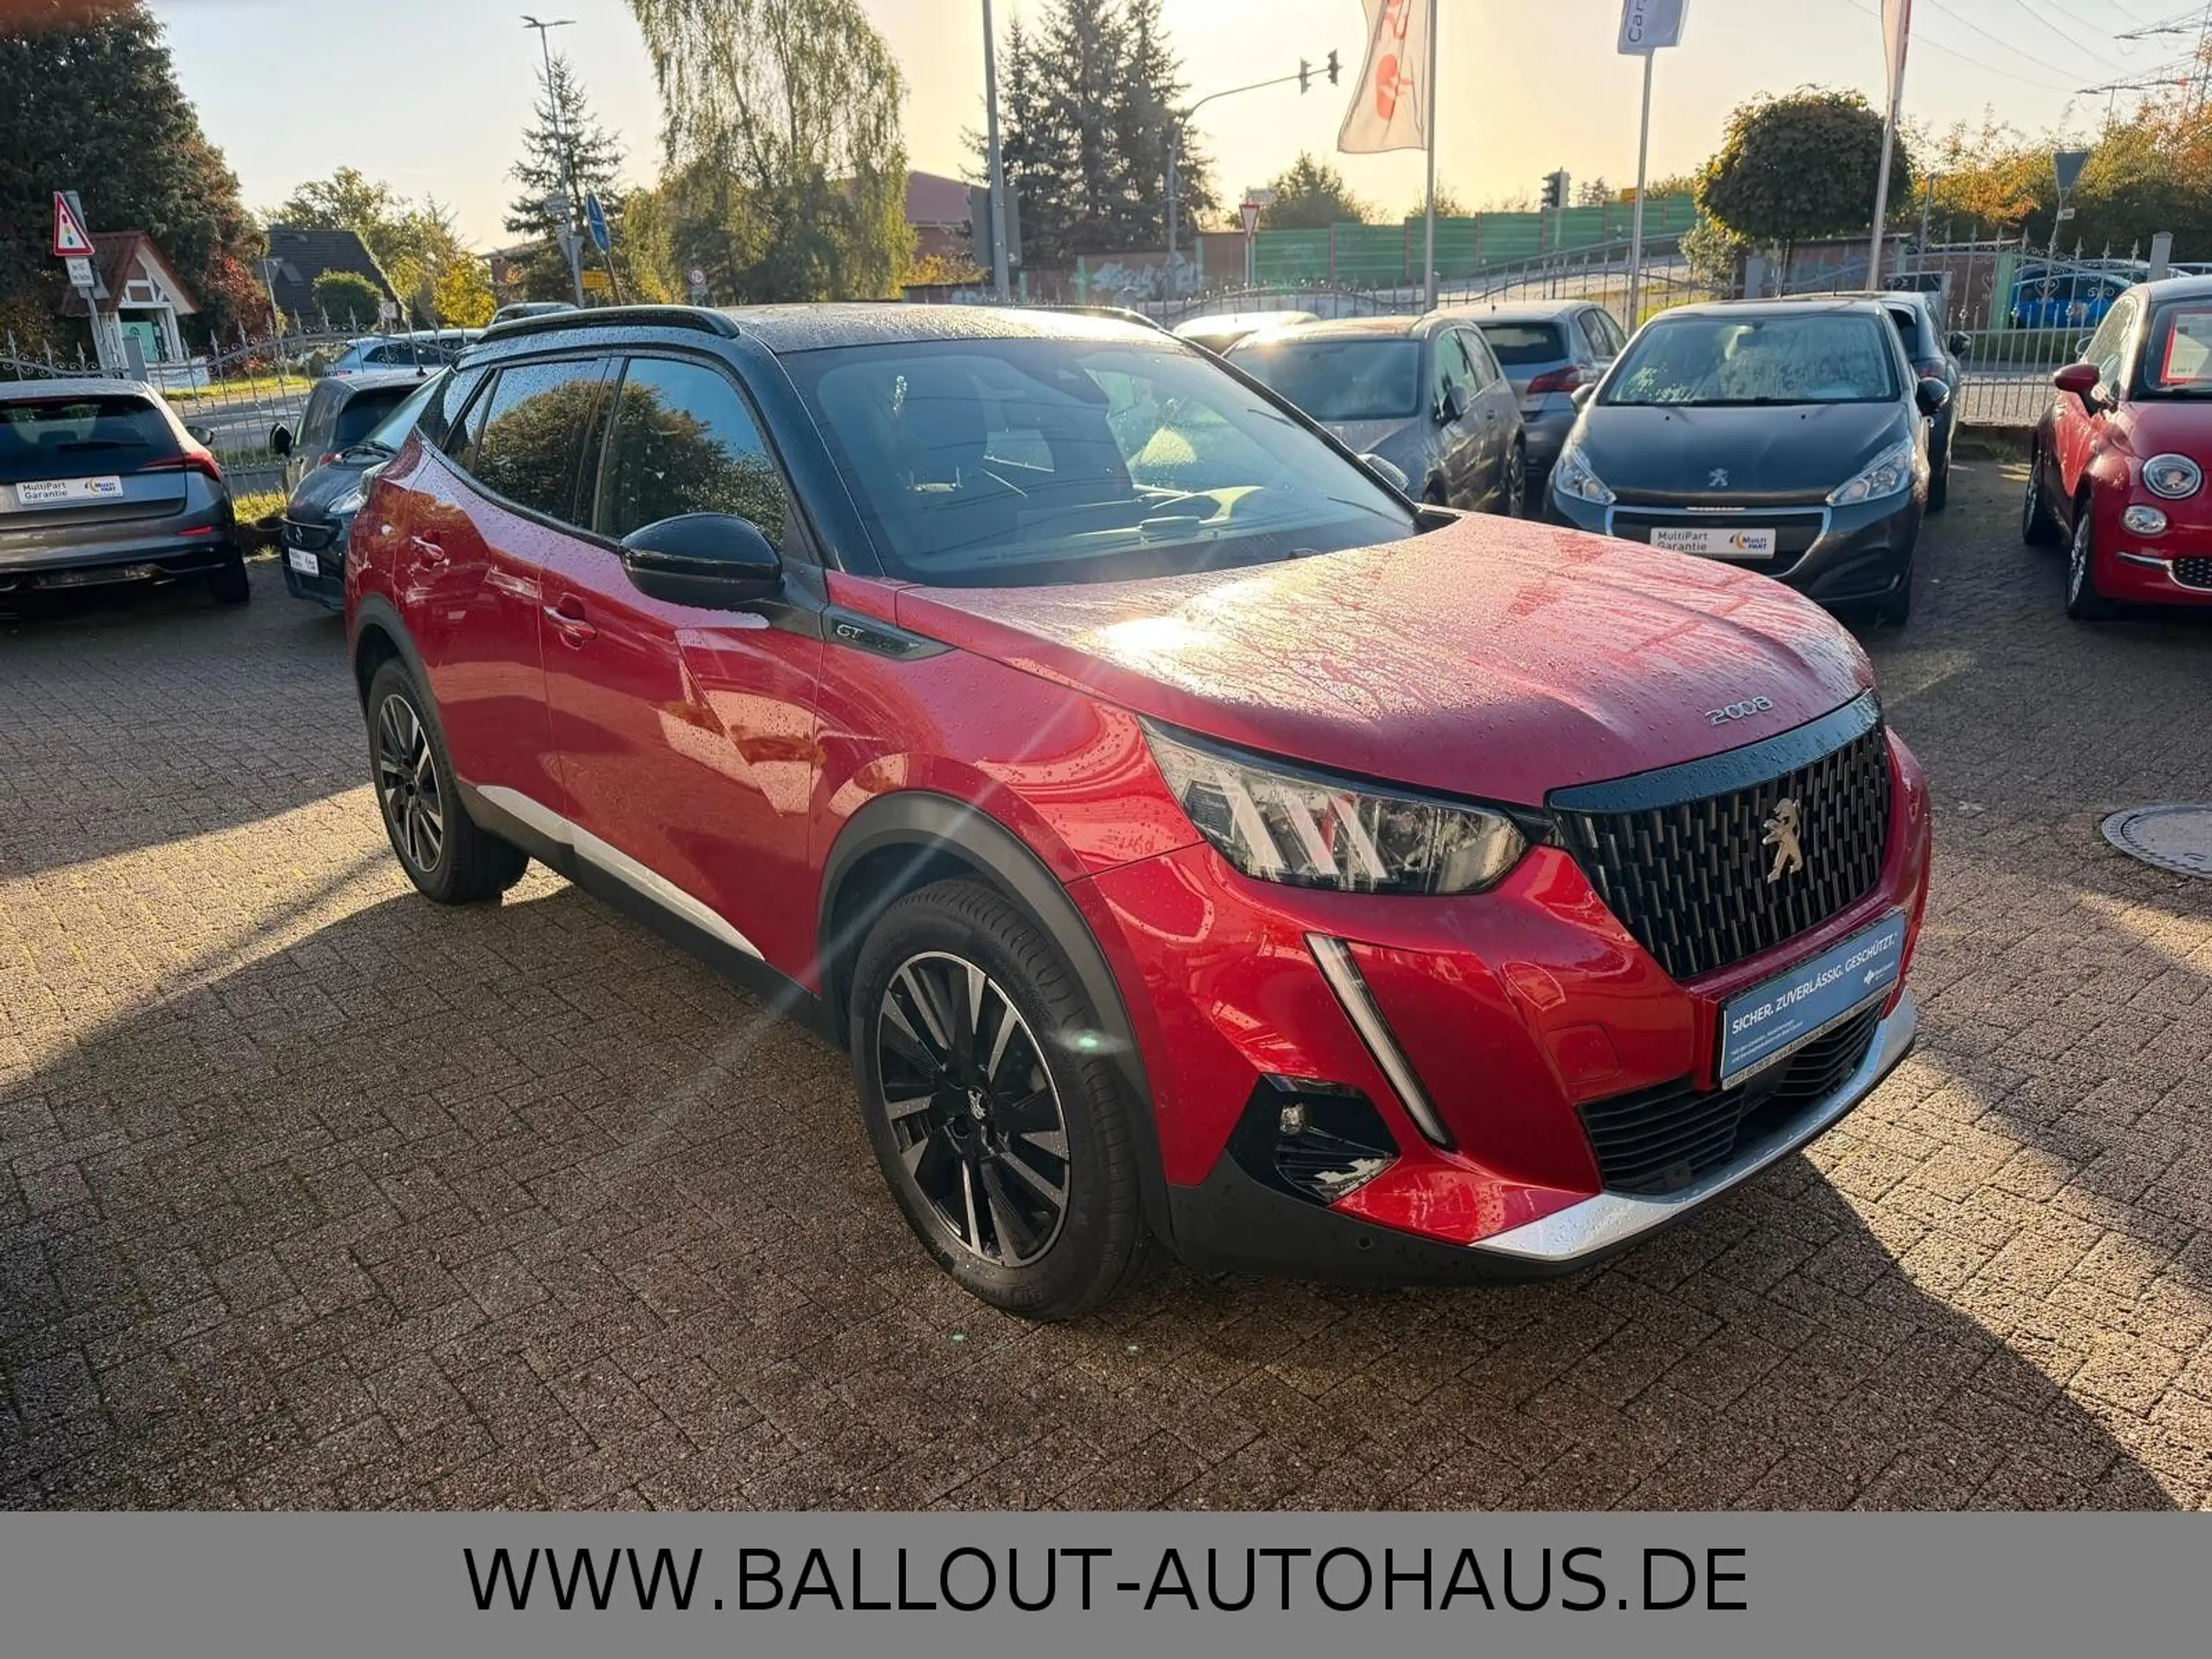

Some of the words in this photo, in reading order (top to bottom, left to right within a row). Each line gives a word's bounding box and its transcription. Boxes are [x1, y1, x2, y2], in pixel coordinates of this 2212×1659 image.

[1628, 0, 1647, 42] Car
[23, 482, 66, 491] MultiPart
[25, 491, 67, 499] Garantie
[1658, 531, 1707, 540] MultiPart
[1658, 541, 1707, 551] Garantie
[836, 624, 865, 641] GT
[1705, 696, 1774, 726] 2008
[1732, 1003, 1774, 1035] SICHER.
[1775, 965, 1844, 1012] ZUVERLÄSSIG.
